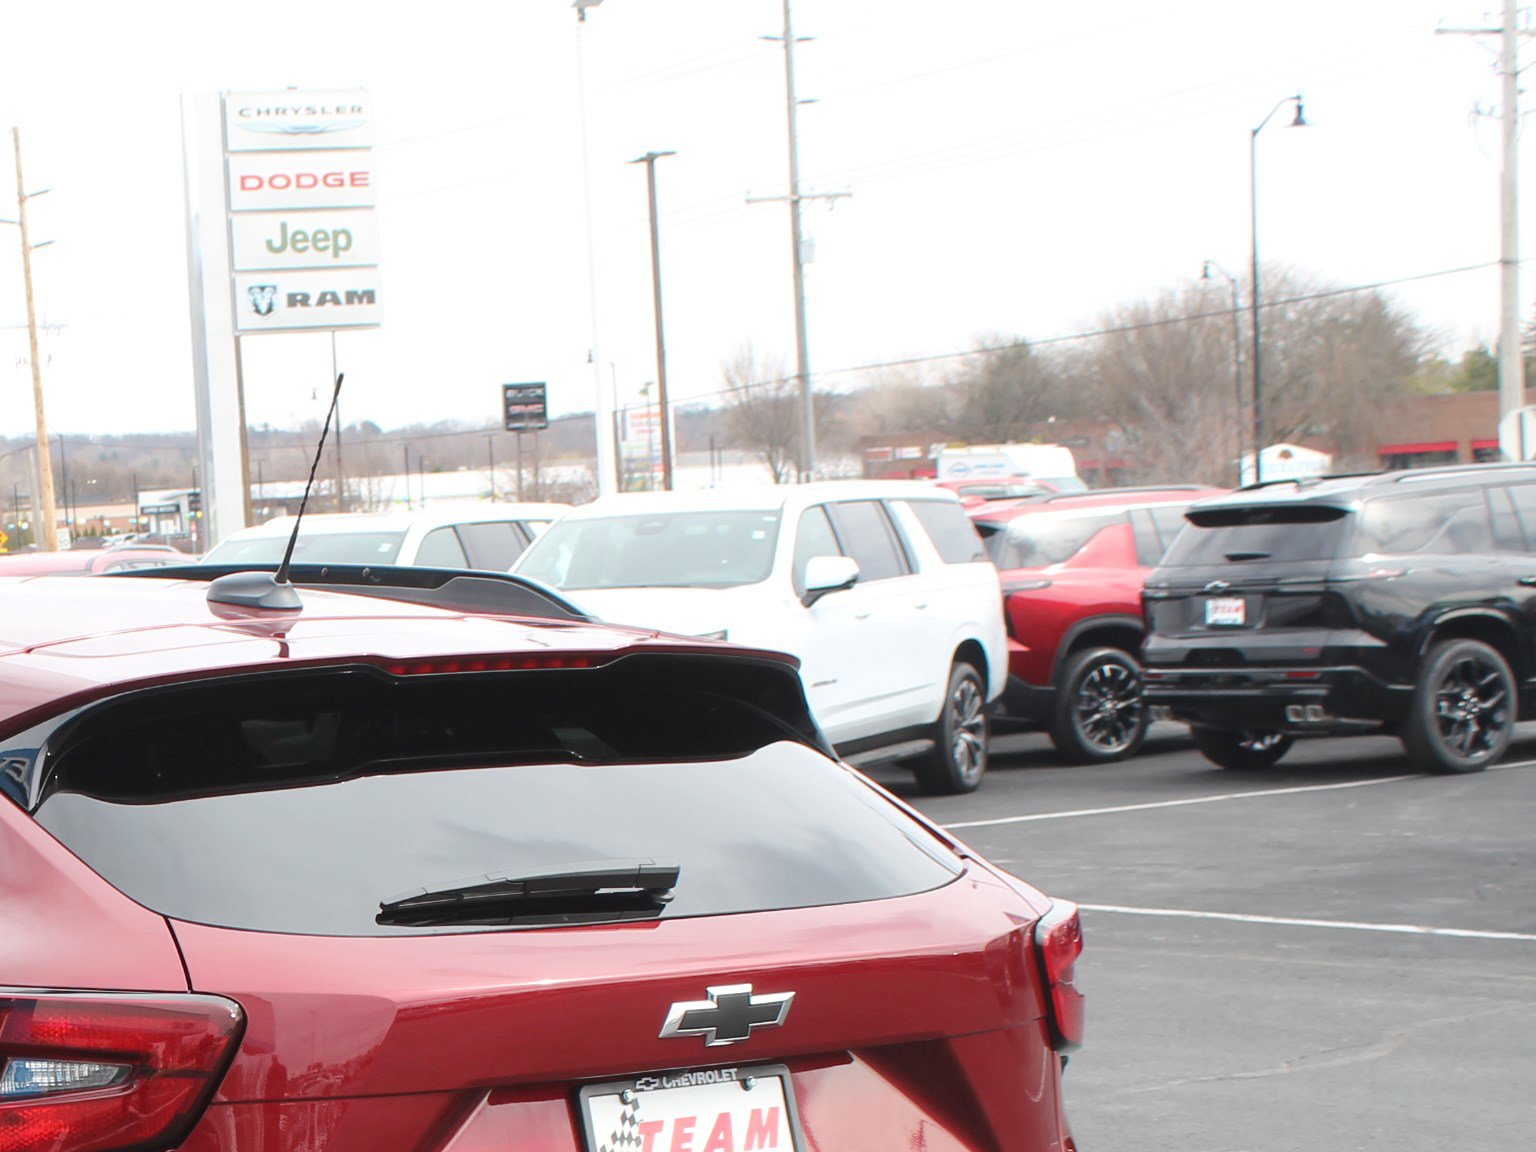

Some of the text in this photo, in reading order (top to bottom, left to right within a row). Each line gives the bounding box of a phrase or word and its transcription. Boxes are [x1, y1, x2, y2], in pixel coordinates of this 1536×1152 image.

[238, 105, 364, 118] CHRYSLER
[239, 171, 370, 192] DODGE
[265, 221, 353, 259] Jeep
[286, 289, 376, 308] RAM
[662, 1068, 738, 1089] CHEVROLET
